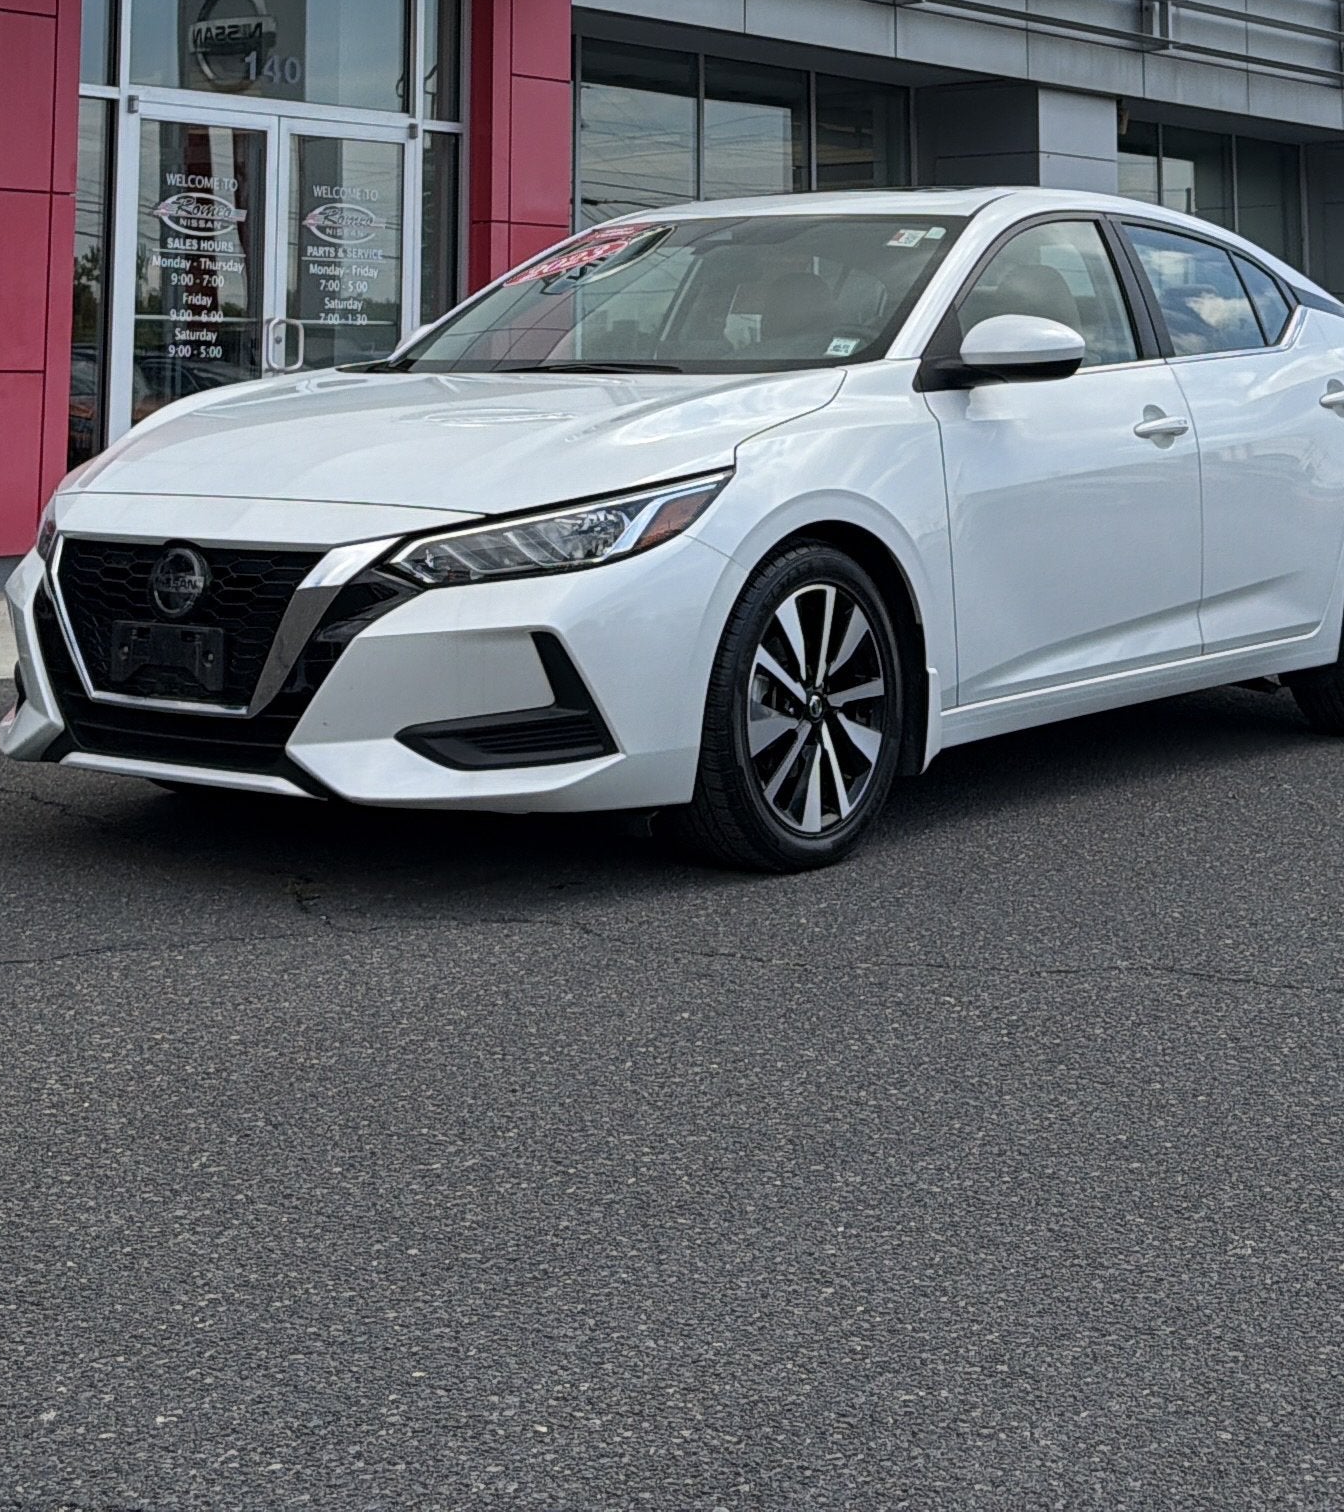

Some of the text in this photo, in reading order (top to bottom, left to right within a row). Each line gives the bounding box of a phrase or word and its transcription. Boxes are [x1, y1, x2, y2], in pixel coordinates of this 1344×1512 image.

[244, 51, 302, 84] 140
[166, 173, 238, 191] WELCOME TO
[312, 185, 361, 199] WELCOME
[171, 194, 232, 218] Romeo
[179, 218, 221, 229] NISSAN
[167, 238, 234, 252] SALES HOURS
[307, 246, 383, 259] PARTS & SERVICE
[152, 255, 191, 271] Monday
[200, 258, 244, 273] Thursday
[309, 263, 344, 278] Monday
[352, 265, 378, 279] Friday
[171, 273, 194, 285] 9:00
[202, 275, 224, 287] 7:00
[320, 279, 340, 291] 7:00
[348, 281, 368, 293] 5:00
[183, 293, 213, 308] Friday
[324, 297, 363, 312] Saturday
[170, 309, 193, 321] 9:00
[201, 310, 224, 322] 6:00
[319, 313, 339, 325] 7:00
[348, 314, 368, 325] 1:30
[175, 328, 218, 344] Saturday
[169, 345, 191, 357] 9:00
[200, 346, 222, 358] 5:00
